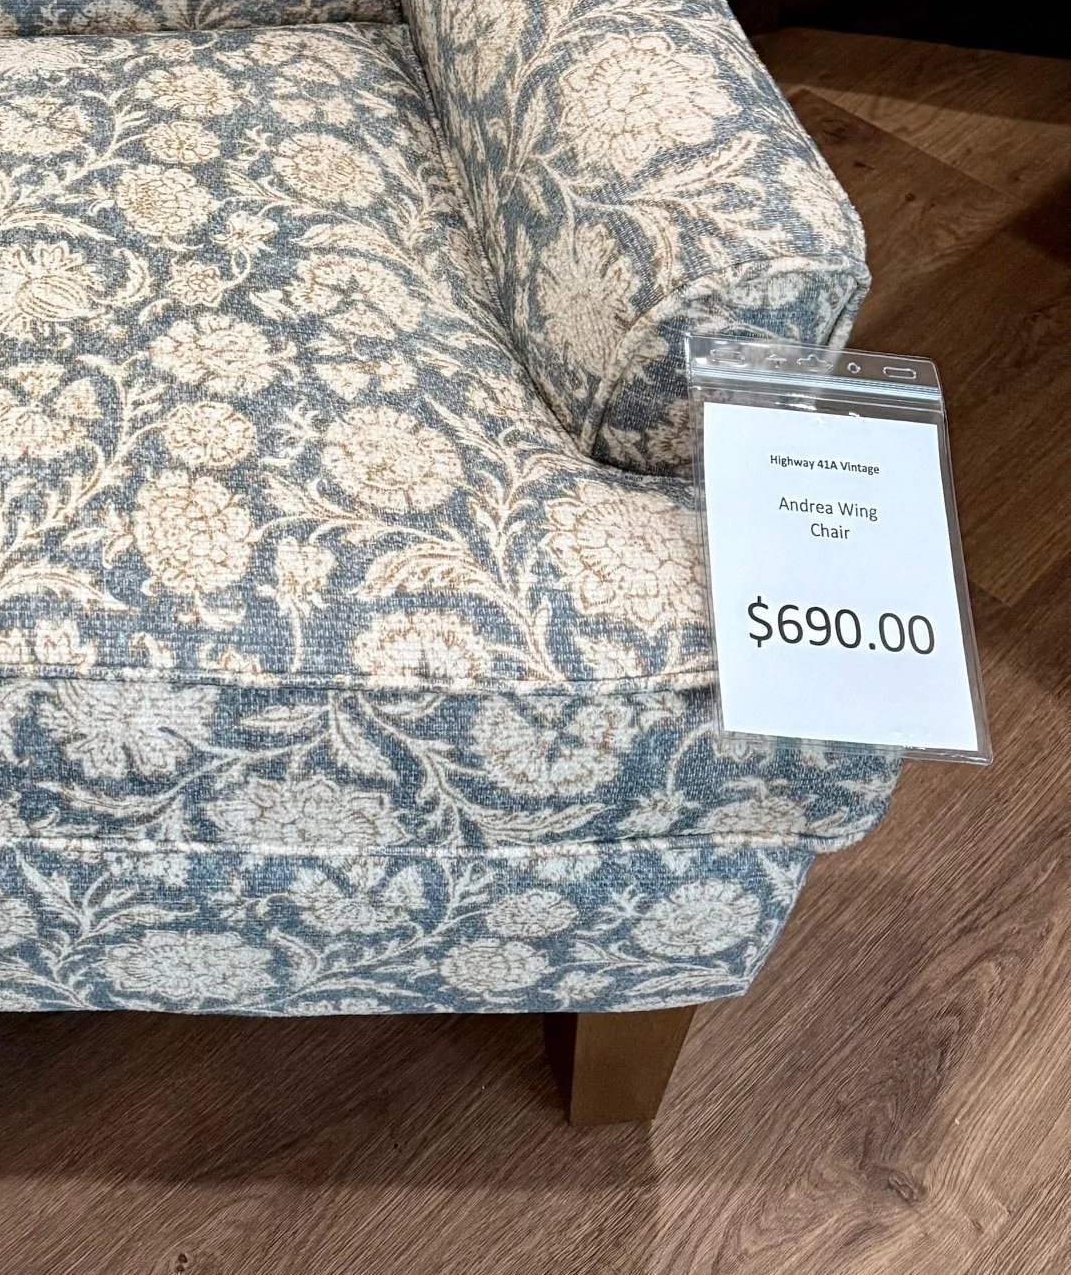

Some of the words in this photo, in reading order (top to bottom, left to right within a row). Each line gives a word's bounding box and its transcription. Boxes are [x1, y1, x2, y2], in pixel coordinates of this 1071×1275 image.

[770, 454, 815, 470] Highway
[817, 459, 838, 471] 41A
[840, 461, 880, 476] Vintage
[778, 496, 834, 515] Andrea
[838, 501, 878, 522] Wing
[810, 522, 851, 540] Chair
[747, 595, 935, 655] $690.00
